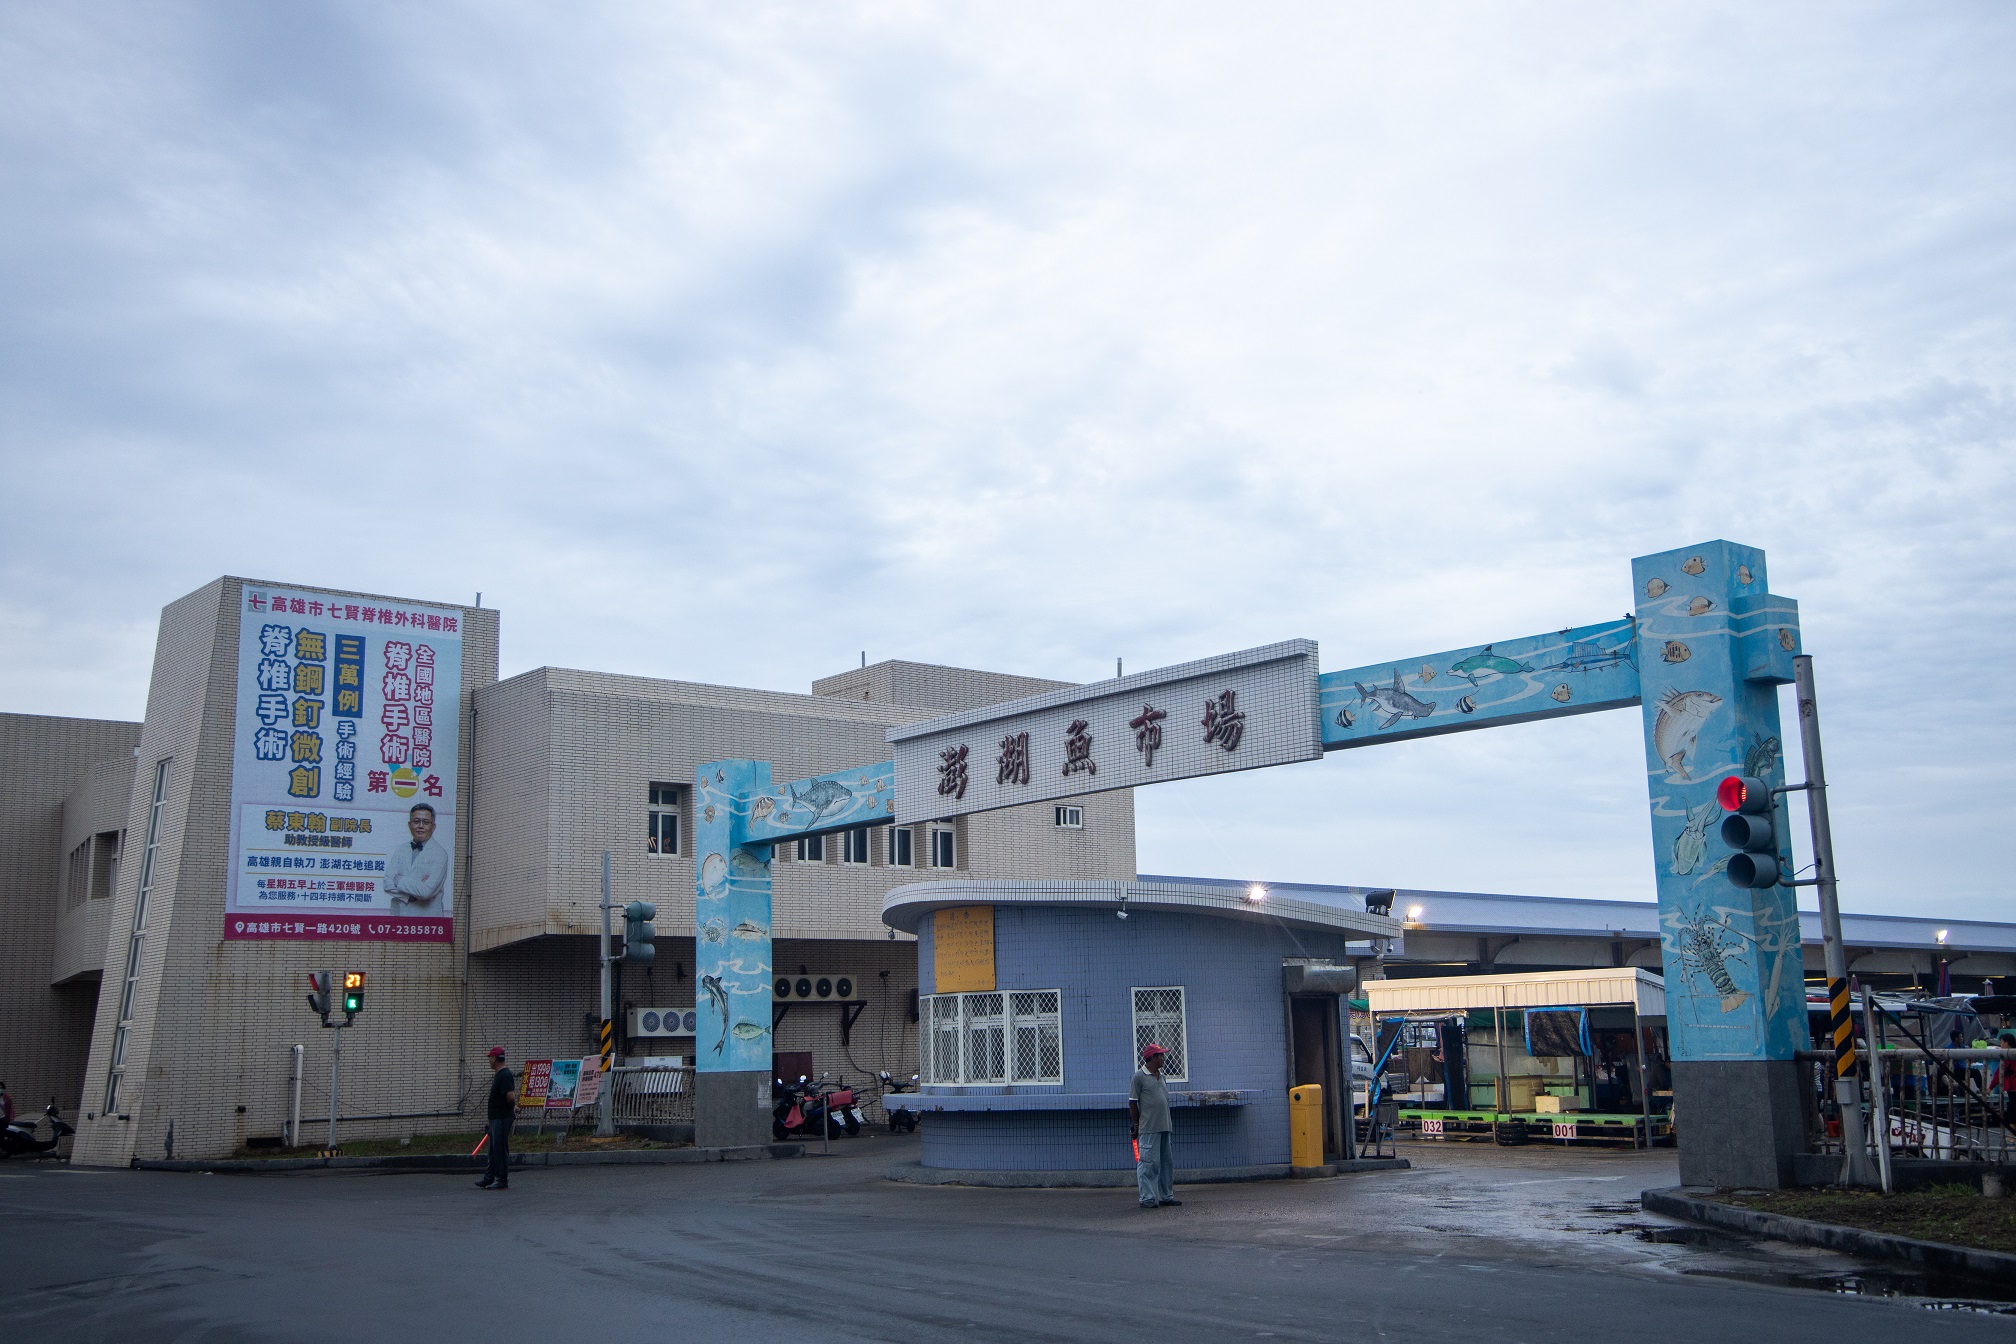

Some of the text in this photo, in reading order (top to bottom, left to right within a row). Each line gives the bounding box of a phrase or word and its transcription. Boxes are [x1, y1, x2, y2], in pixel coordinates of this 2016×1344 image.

[271, 595, 458, 633] 高雄市七賢脊椎外科醫院
[254, 624, 293, 761] 脊椎手術
[380, 640, 413, 764] 脊椎手術
[288, 627, 326, 798] 無鋼釘微創
[411, 644, 435, 768] 全國地區醫院
[334, 639, 359, 801] 三萬例 手術經驗
[936, 688, 1245, 799] 澎湖魚市場
[367, 770, 443, 798] 第一名
[265, 810, 372, 833] 蔡東翰 副院長
[284, 834, 353, 848] 助教授級醫師
[247, 856, 386, 872] 高雄親自執刀 澎湖在地追蹤
[257, 879, 375, 892] 每星期五早上於三軍總醫院
[246, 922, 444, 935] 高雄市七賢一路420號 07-2385878
[346, 974, 361, 988] 27
[1423, 1121, 1442, 1133] 032
[1554, 1124, 1575, 1137] 001
